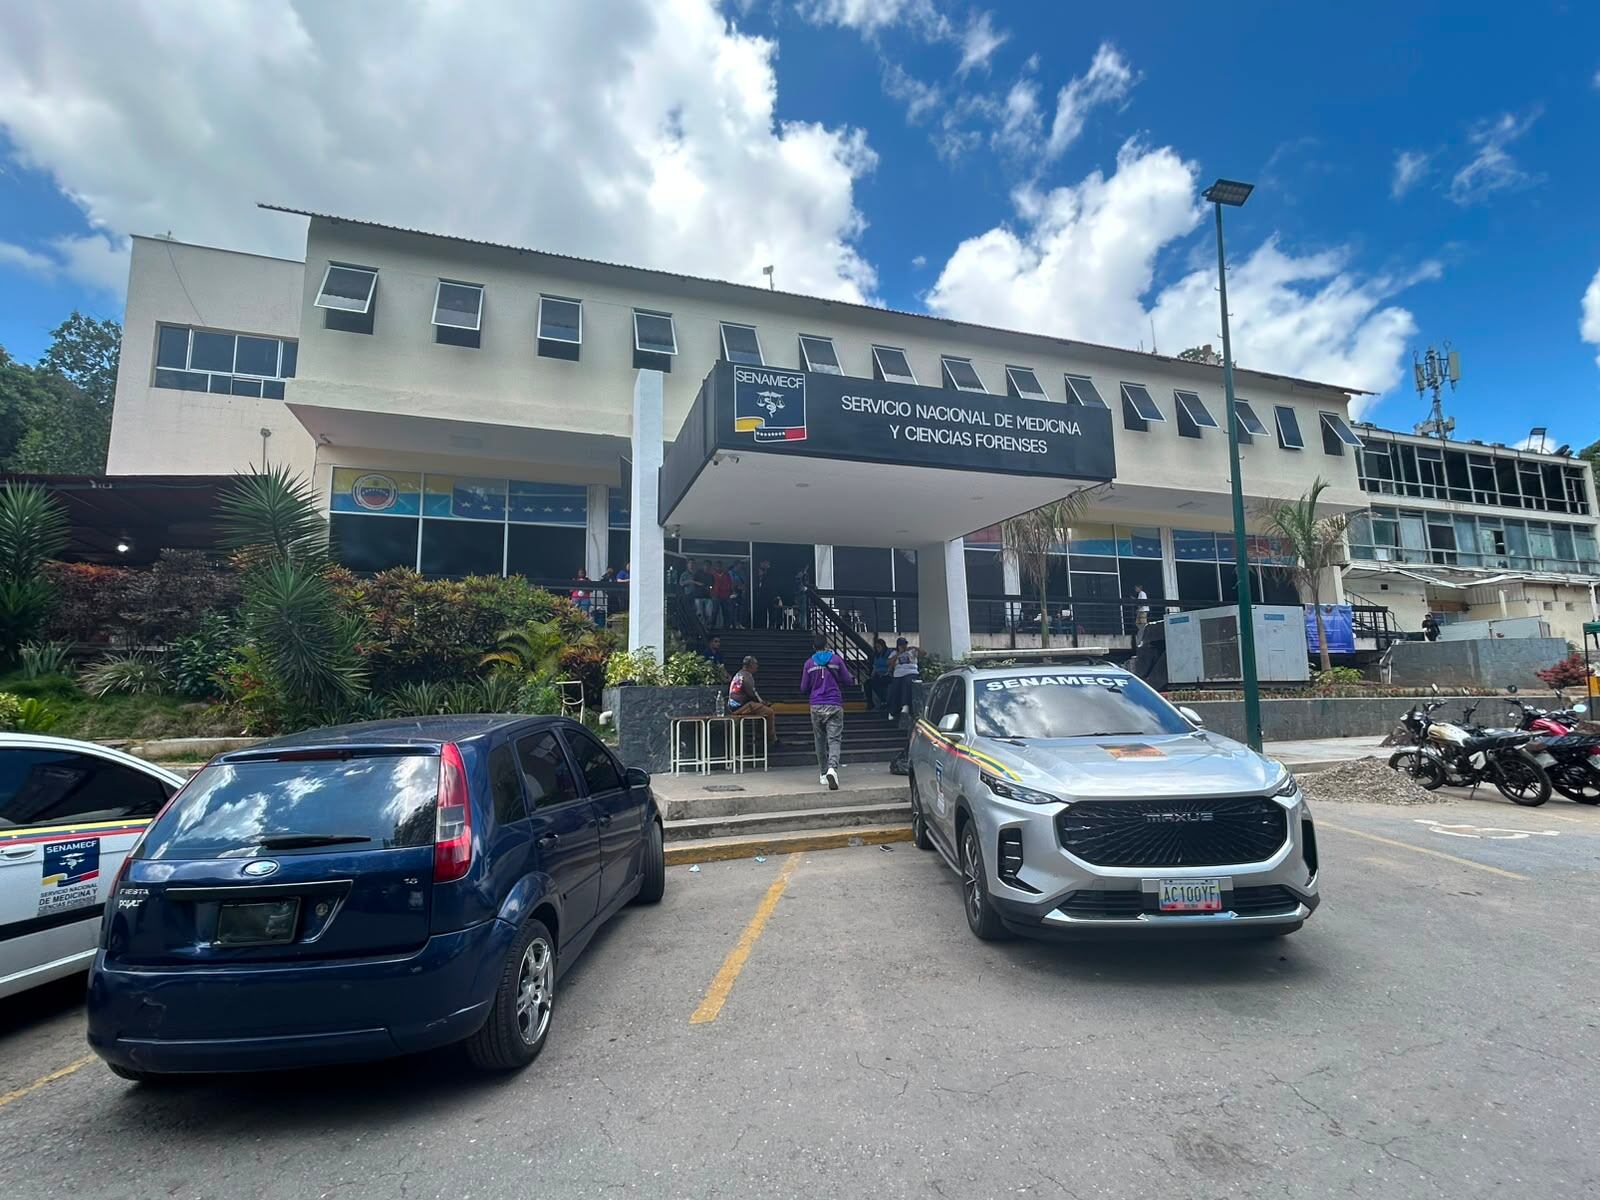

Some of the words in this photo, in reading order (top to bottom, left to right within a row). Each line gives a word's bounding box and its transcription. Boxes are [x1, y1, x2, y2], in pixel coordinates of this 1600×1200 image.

[736, 370, 804, 389] SENAMECF
[841, 395, 912, 417] SERVICIO
[915, 404, 991, 426] NACIONAL
[994, 413, 1014, 428] DE
[1016, 415, 1082, 436] MEDICINA
[889, 424, 900, 439] Y
[904, 426, 972, 446] CIENCIAS
[975, 433, 1048, 454] FORENSES
[986, 676, 1129, 691] SENAMECF
[46, 840, 97, 854] SENAMECF
[39, 897, 51, 906] DE
[52, 889, 91, 903] MEDICINA
[40, 888, 68, 898] SERVICIO
[1164, 886, 1215, 902] AC100YF
